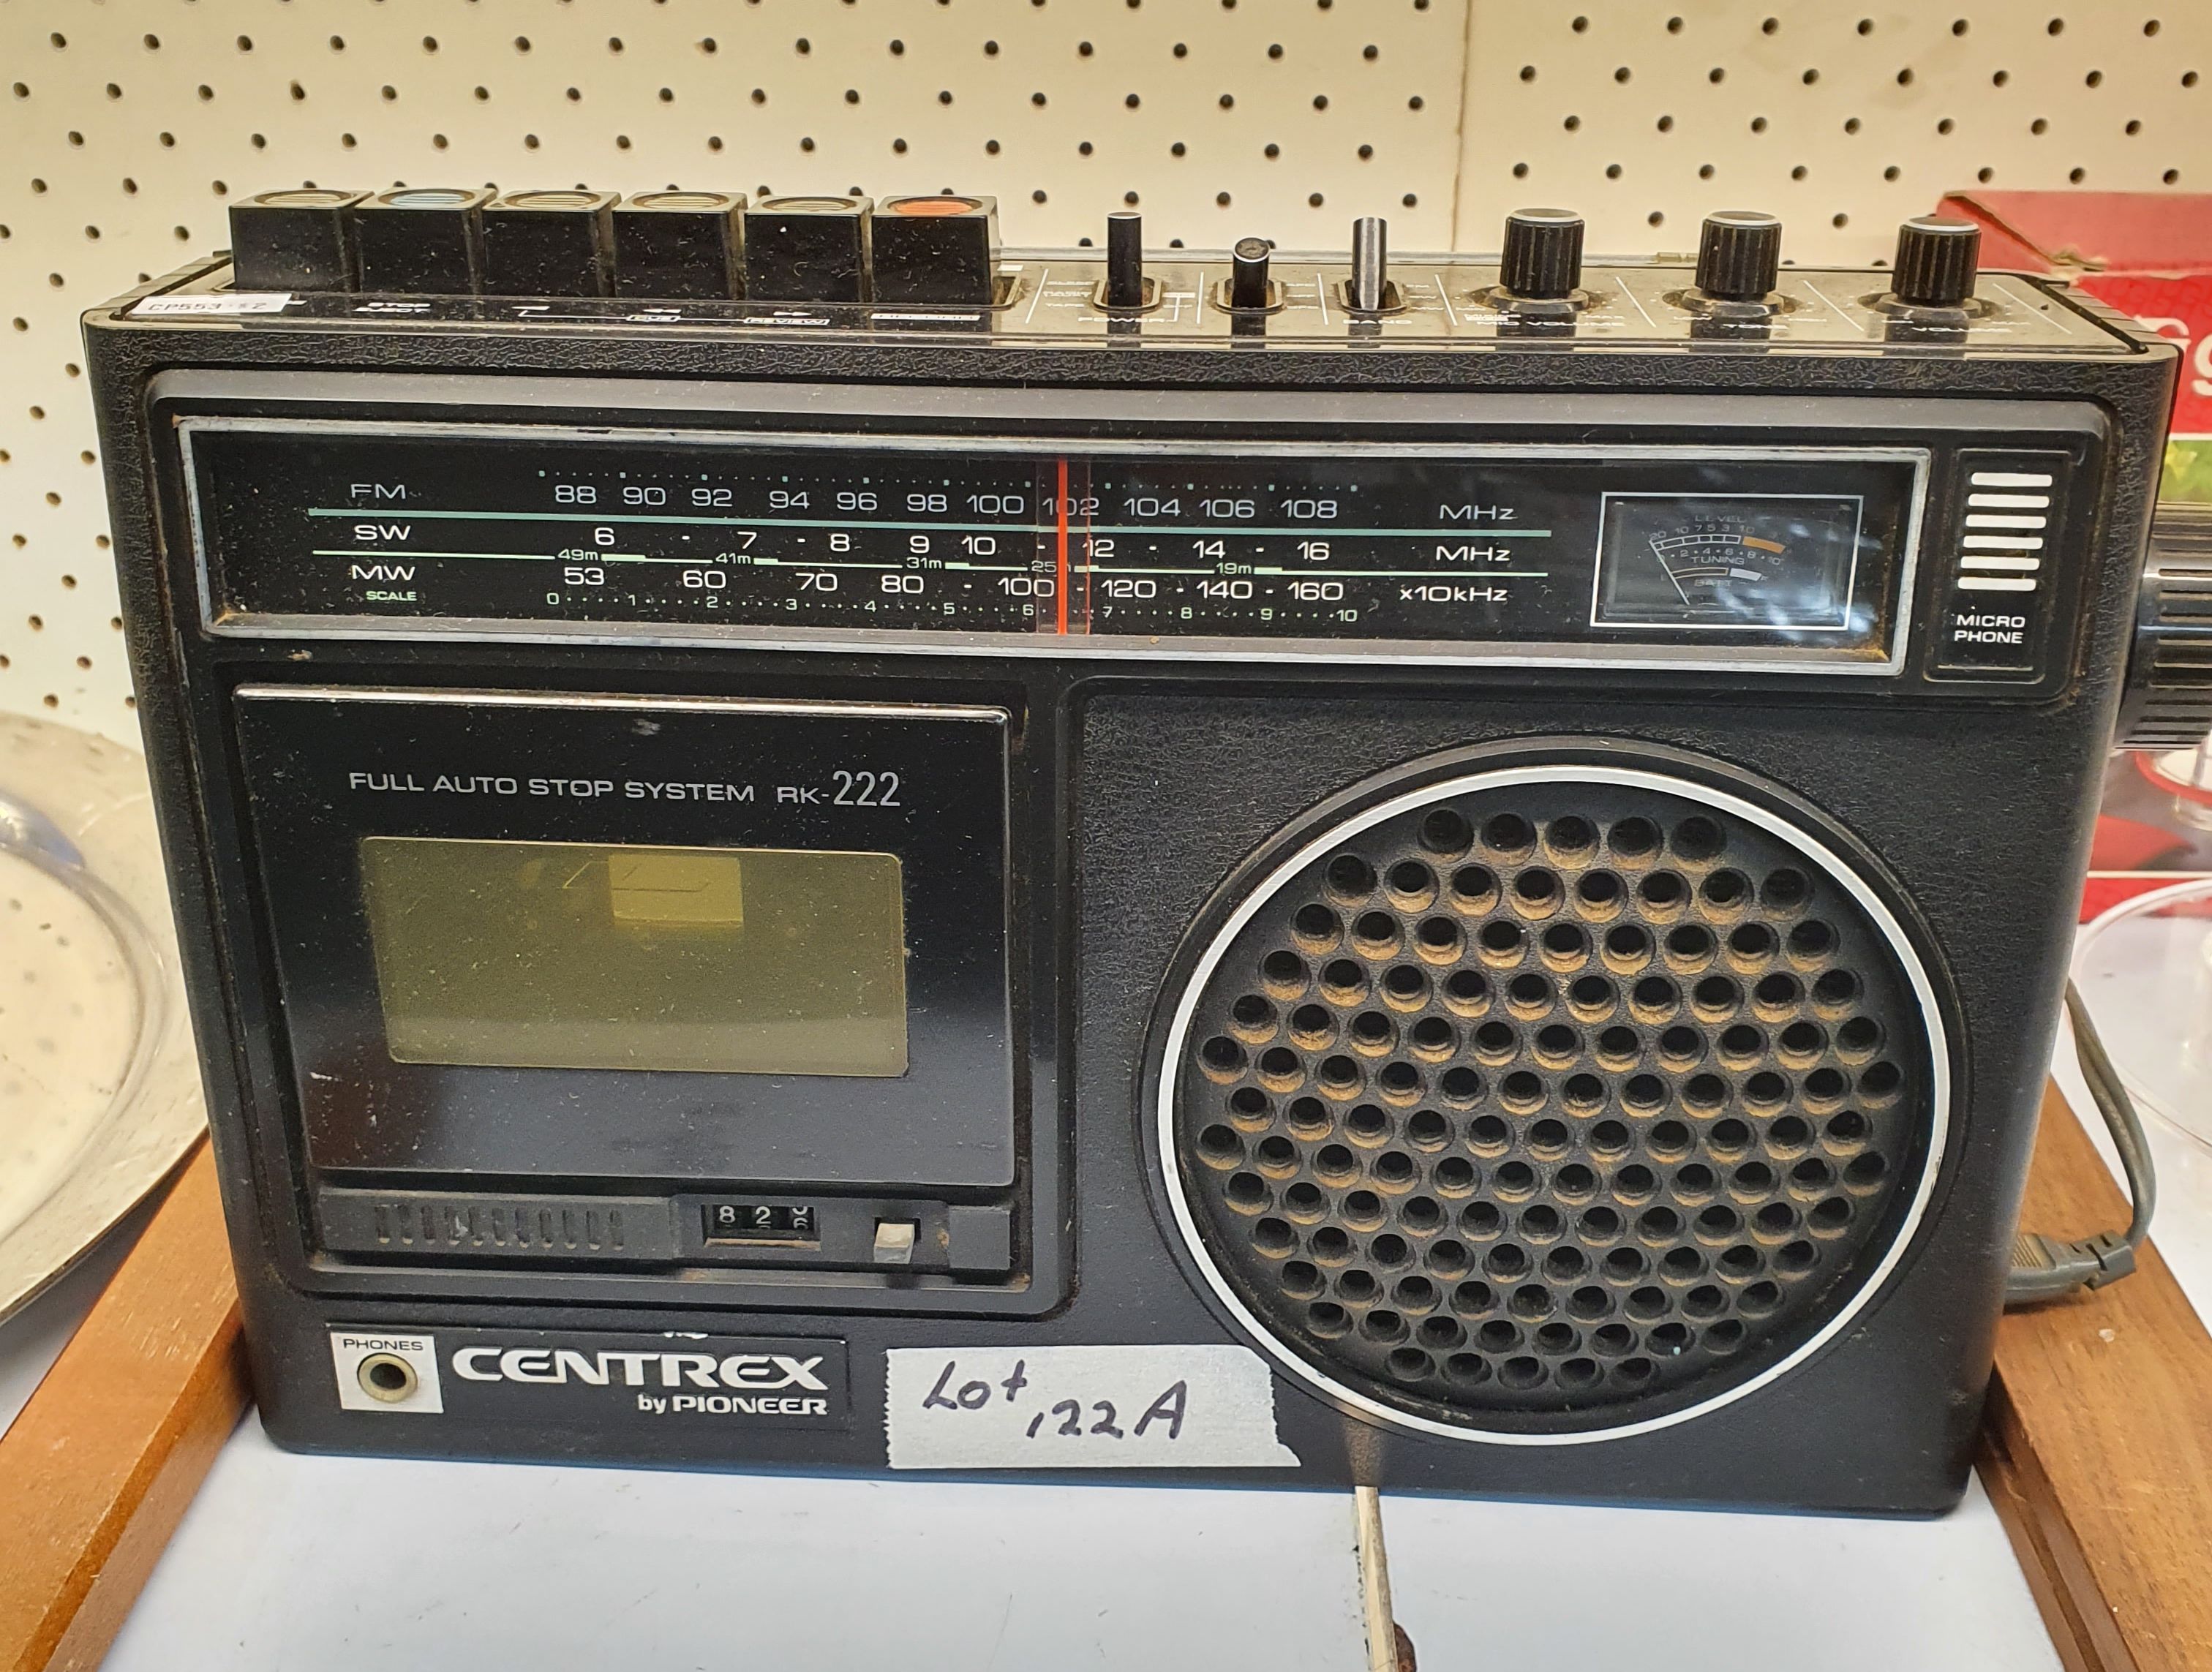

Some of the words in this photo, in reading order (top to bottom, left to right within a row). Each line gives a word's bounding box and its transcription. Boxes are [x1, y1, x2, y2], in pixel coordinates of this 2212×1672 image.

[350, 483, 406, 500] FM
[555, 485, 596, 503] 88
[623, 487, 666, 505] 90
[692, 489, 732, 506] 92
[770, 491, 809, 508] 94
[837, 492, 877, 510] 96
[907, 494, 947, 512] 98
[967, 495, 1023, 513] 100
[1124, 498, 1181, 516] 104
[1200, 500, 1254, 518] 106
[1281, 500, 1337, 518] 108
[1440, 504, 1517, 520] MHz
[355, 525, 410, 540] SW
[595, 527, 615, 546] 6
[737, 532, 756, 549] 7
[831, 534, 849, 551] 8
[910, 536, 929, 553] 9
[962, 536, 996, 554] 10
[1080, 538, 1116, 558] 12
[1193, 541, 1225, 558] 14
[1298, 542, 1329, 560] 16
[1436, 546, 1511, 561] MHz
[557, 549, 598, 561] 49m
[715, 552, 751, 565] 41m
[907, 557, 941, 568] 31m
[1031, 560, 1071, 574] 25
[1216, 562, 1252, 574] 19m
[1691, 556, 1745, 565] TUNING
[352, 565, 415, 580] MW
[565, 568, 604, 584] 53
[683, 570, 726, 588] 60
[796, 573, 837, 591] 70
[881, 576, 923, 593] 80
[997, 576, 1055, 598] 100
[1102, 580, 1156, 598] 120
[1197, 581, 1252, 598] 140
[1288, 582, 1343, 600] 160
[366, 591, 417, 600] SCALE
[707, 596, 718, 608] 2
[786, 599, 797, 610] 3
[865, 600, 876, 611] 4
[944, 603, 955, 614] 5
[1023, 604, 1034, 615] 6
[1103, 606, 1112, 617] 7
[1181, 607, 1192, 619] 8
[1261, 609, 1272, 620] 9
[1337, 610, 1357, 622] 10
[1957, 615, 2025, 628] MICRO
[1955, 630, 2023, 643] PHONE
[350, 773, 424, 791] FULL
[433, 775, 517, 794] AUTO
[529, 779, 613, 797] STOP
[625, 781, 753, 801] SYSTEM
[778, 771, 900, 806] RK-222
[343, 1339, 424, 1352] PHONES
[453, 1348, 828, 1390] CENTREX
[922, 1360, 1027, 1409] Lot
[638, 1394, 666, 1414] by
[673, 1396, 827, 1415] PIONEER
